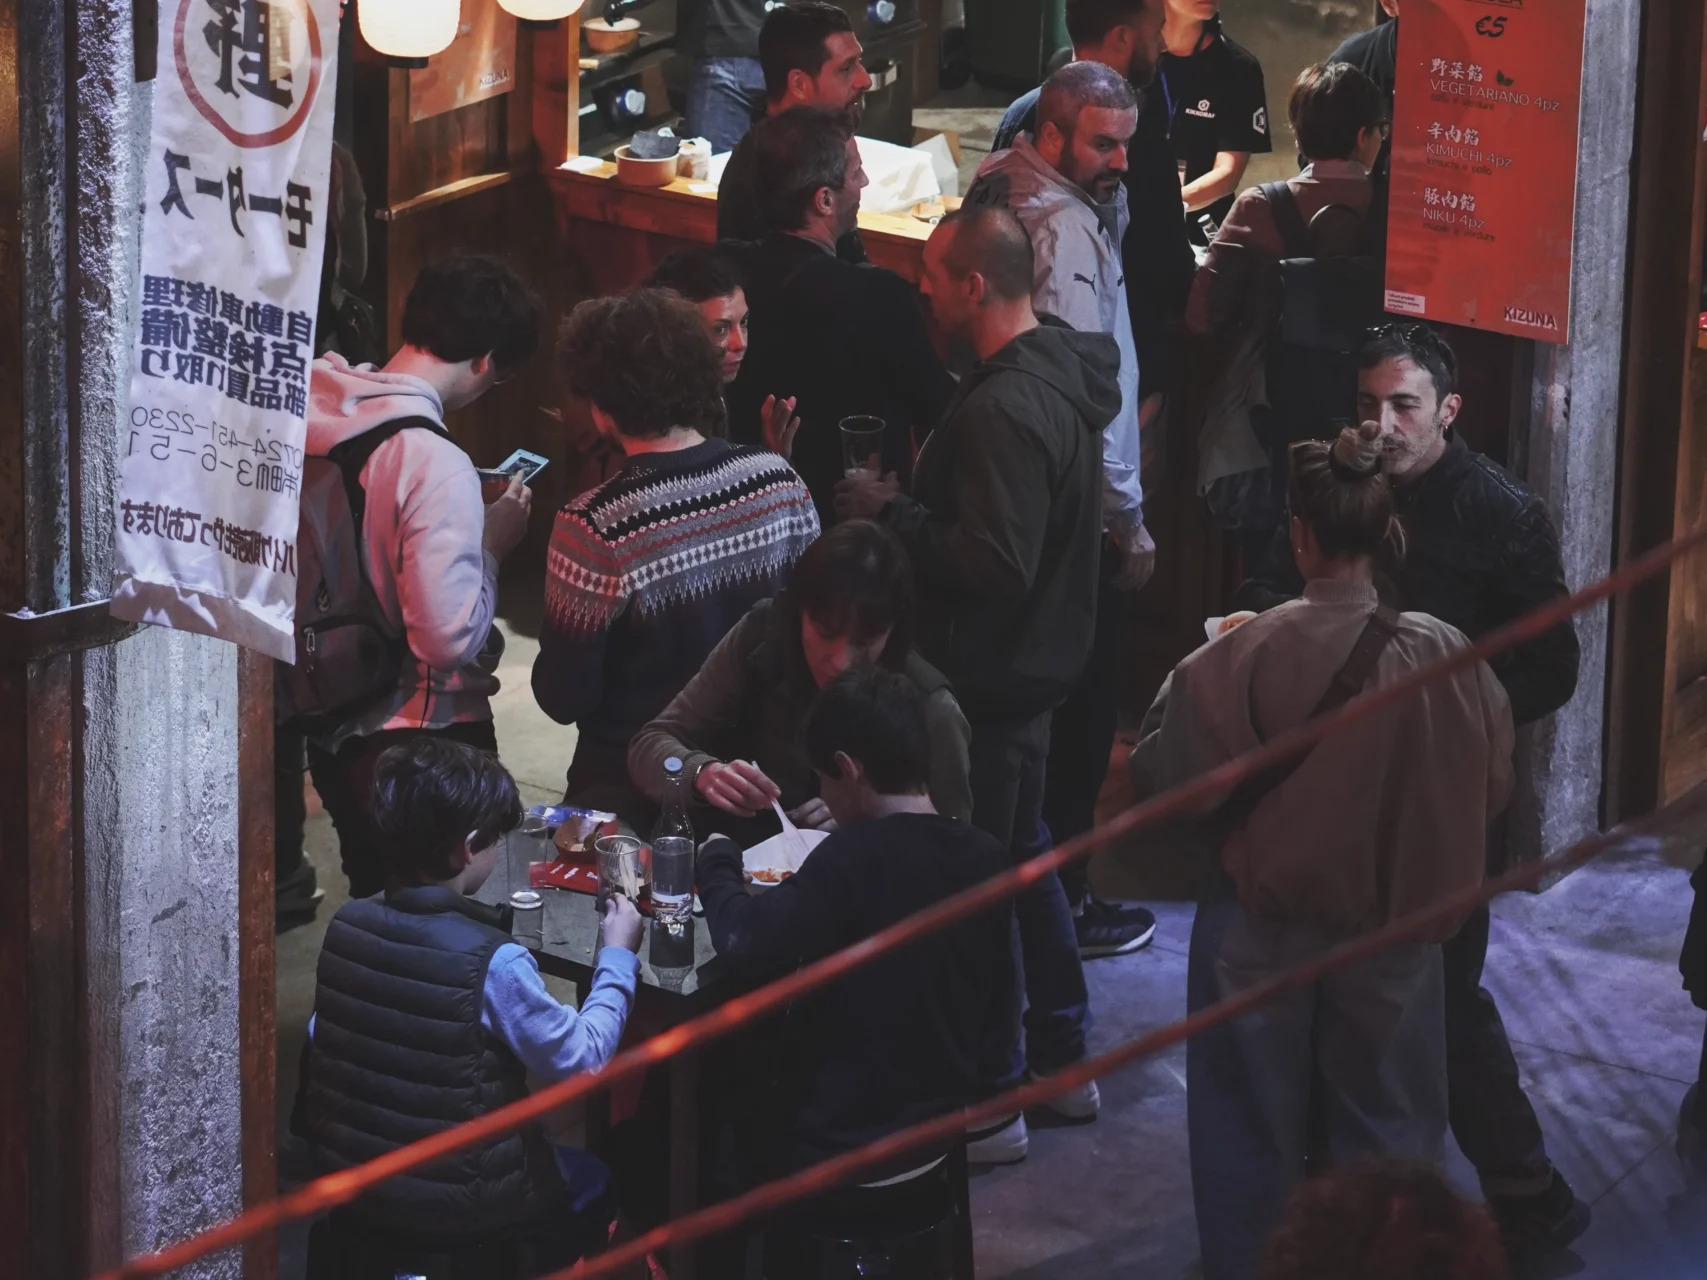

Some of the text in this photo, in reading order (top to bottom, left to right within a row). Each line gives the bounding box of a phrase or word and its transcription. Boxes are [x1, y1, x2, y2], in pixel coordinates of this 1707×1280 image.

[1475, 15, 1509, 38] €5
[1430, 79, 1560, 111] VEGETARIANO 4pz
[1426, 142, 1513, 169] KIMUCHI 4pz
[1423, 207, 1485, 230] NIKU 4pz
[1503, 305, 1558, 331] KIZUNA
